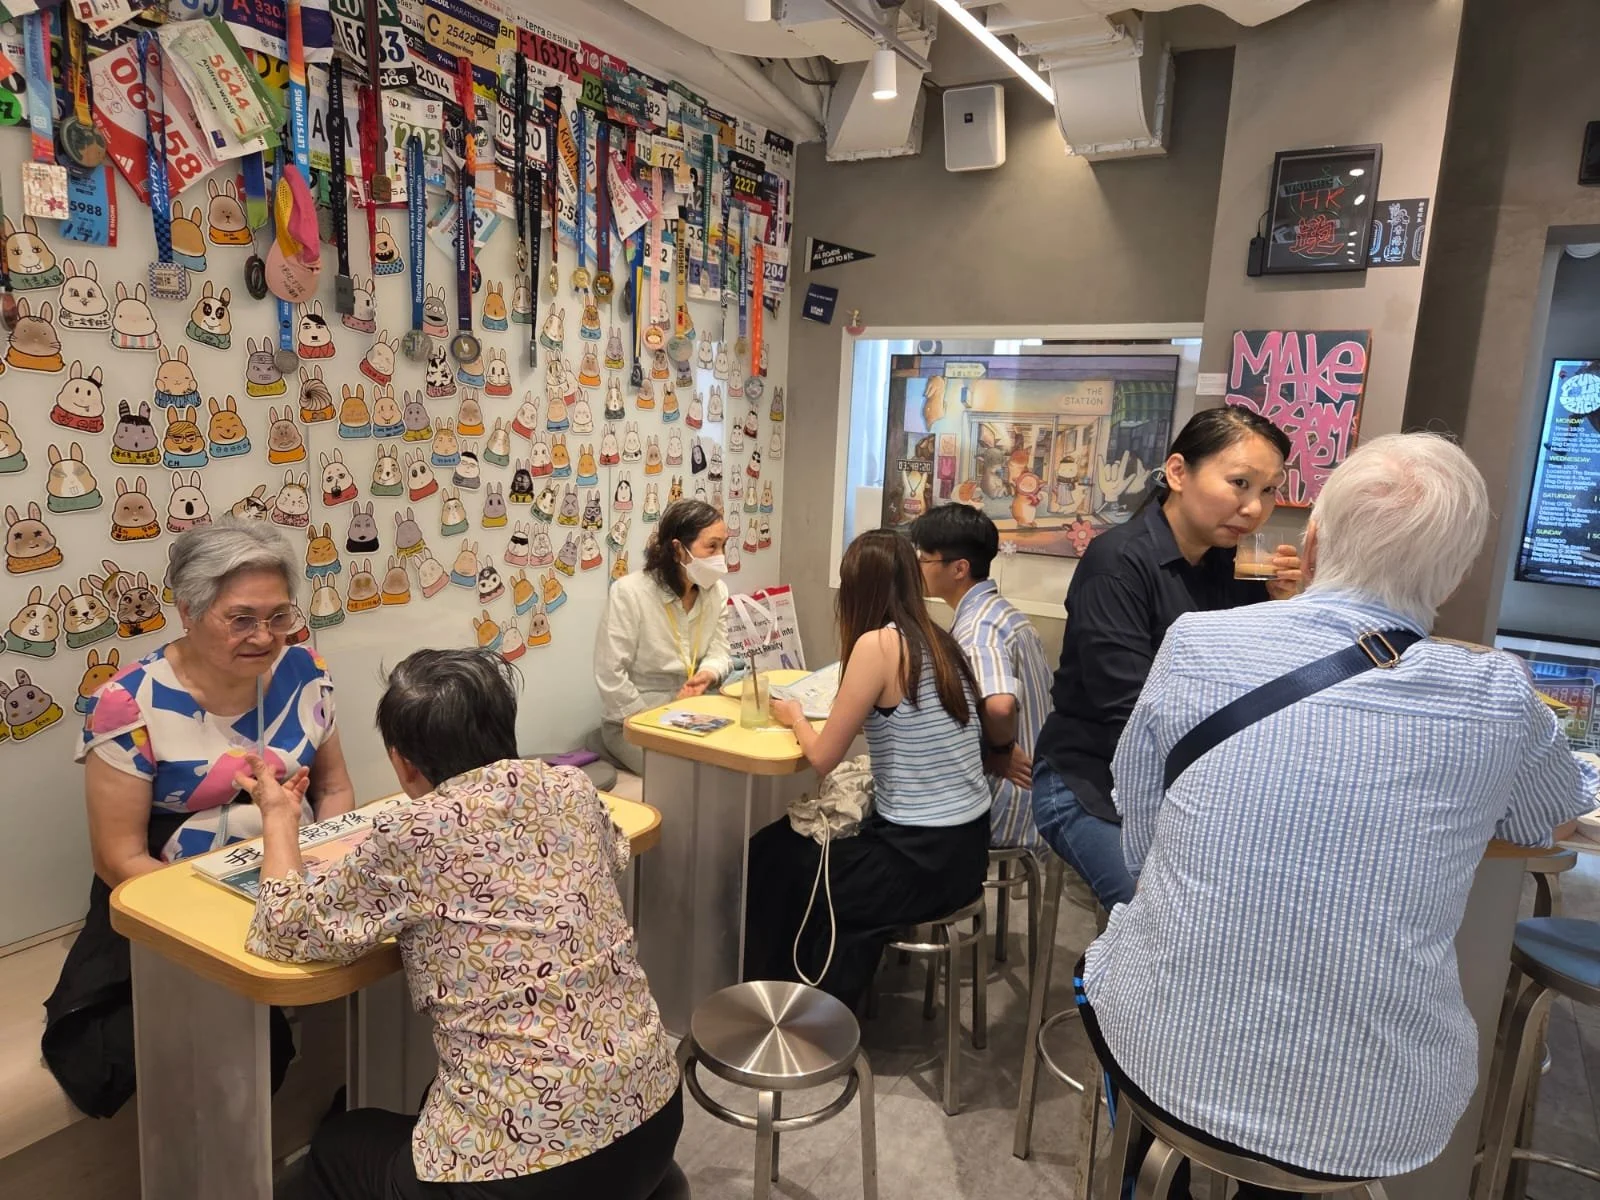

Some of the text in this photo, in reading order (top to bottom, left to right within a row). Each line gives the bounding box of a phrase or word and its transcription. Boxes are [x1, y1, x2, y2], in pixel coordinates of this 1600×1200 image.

[427, 13, 440, 37] C
[209, 53, 250, 112] 5644
[111, 57, 203, 186] 06458
[294, 88, 306, 149] LET'S FLY PARIS
[637, 142, 652, 162] 118
[738, 134, 756, 155] 115
[660, 151, 681, 171] 174
[735, 175, 757, 195] 2227
[1298, 187, 1345, 211] HK
[70, 200, 103, 217] 5988
[415, 174, 424, 303] Standard Chartered Hong Kong Marathon
[813, 252, 822, 261] ALL
[821, 257, 835, 266] LEAD
[1087, 386, 1103, 396] THE
[1064, 396, 1104, 407] STATION
[1555, 417, 1585, 425] MONDAY
[1548, 455, 1591, 463] WEDNESDAY
[1535, 528, 1562, 536] SUNDAY
[782, 626, 794, 636] into
[762, 640, 784, 654] Reality
